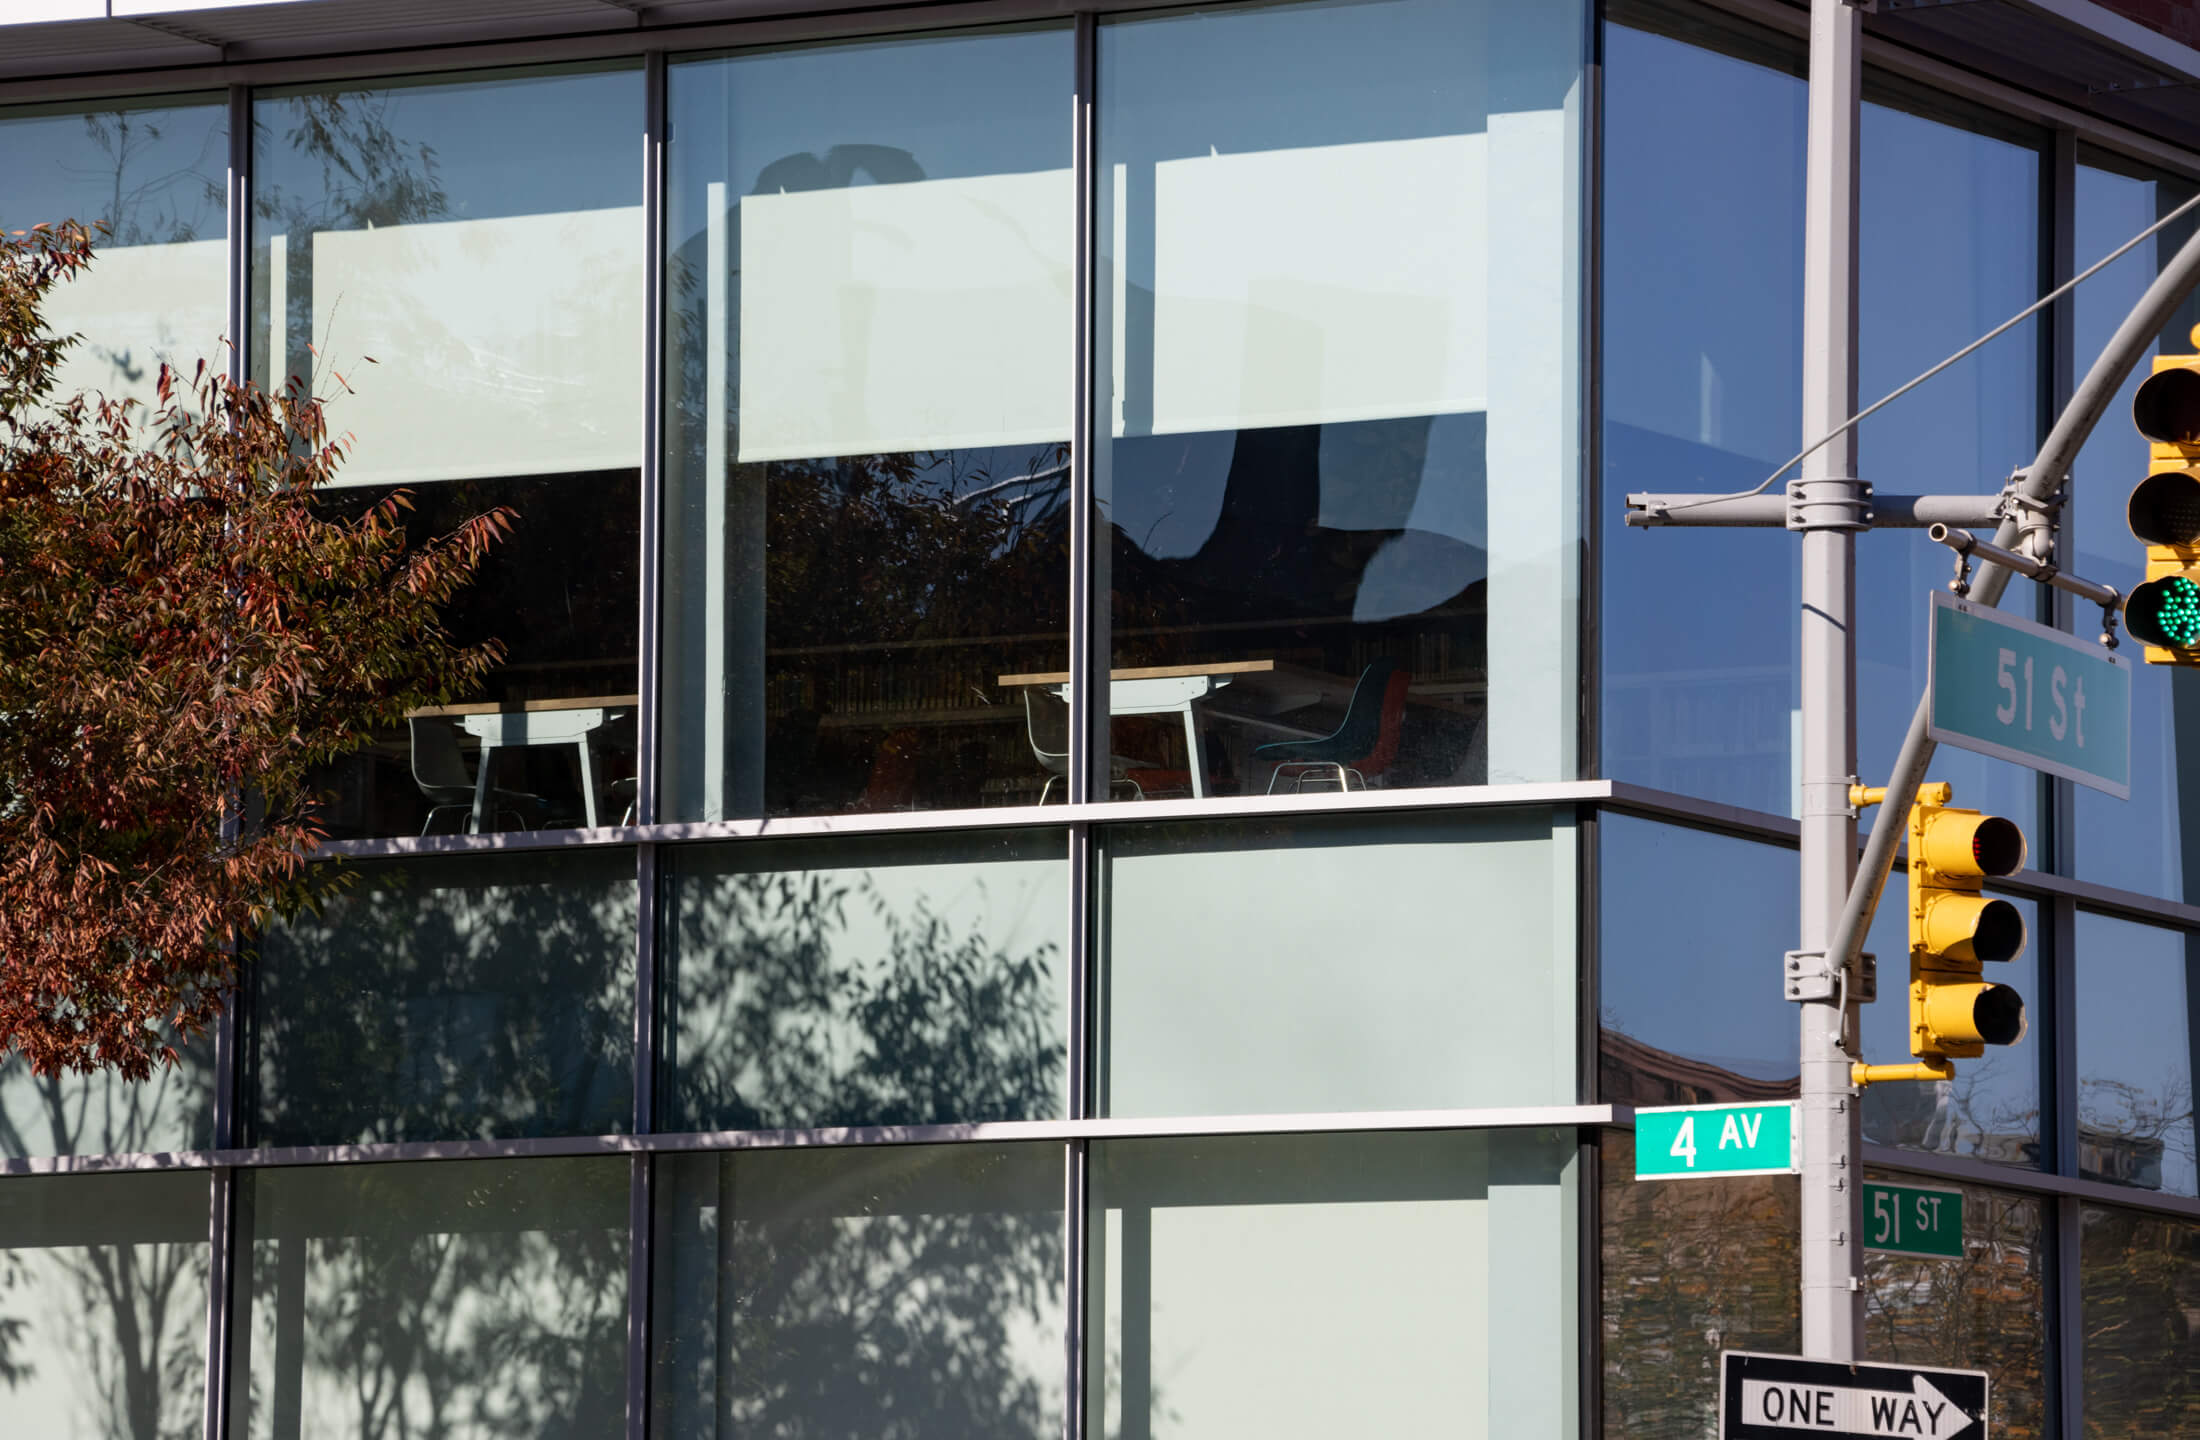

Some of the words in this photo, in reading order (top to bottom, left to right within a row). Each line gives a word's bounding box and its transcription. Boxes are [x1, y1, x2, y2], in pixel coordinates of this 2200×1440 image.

[1997, 648, 2033, 731] 51
[2050, 666, 2086, 748] St
[1670, 1116, 1697, 1167] 4
[1718, 1113, 1762, 1150] AV
[1873, 1191, 1900, 1244] 51
[1916, 1196, 1942, 1232] ST
[1763, 1386, 1835, 1427] ONE
[1872, 1396, 1947, 1436] WAY
